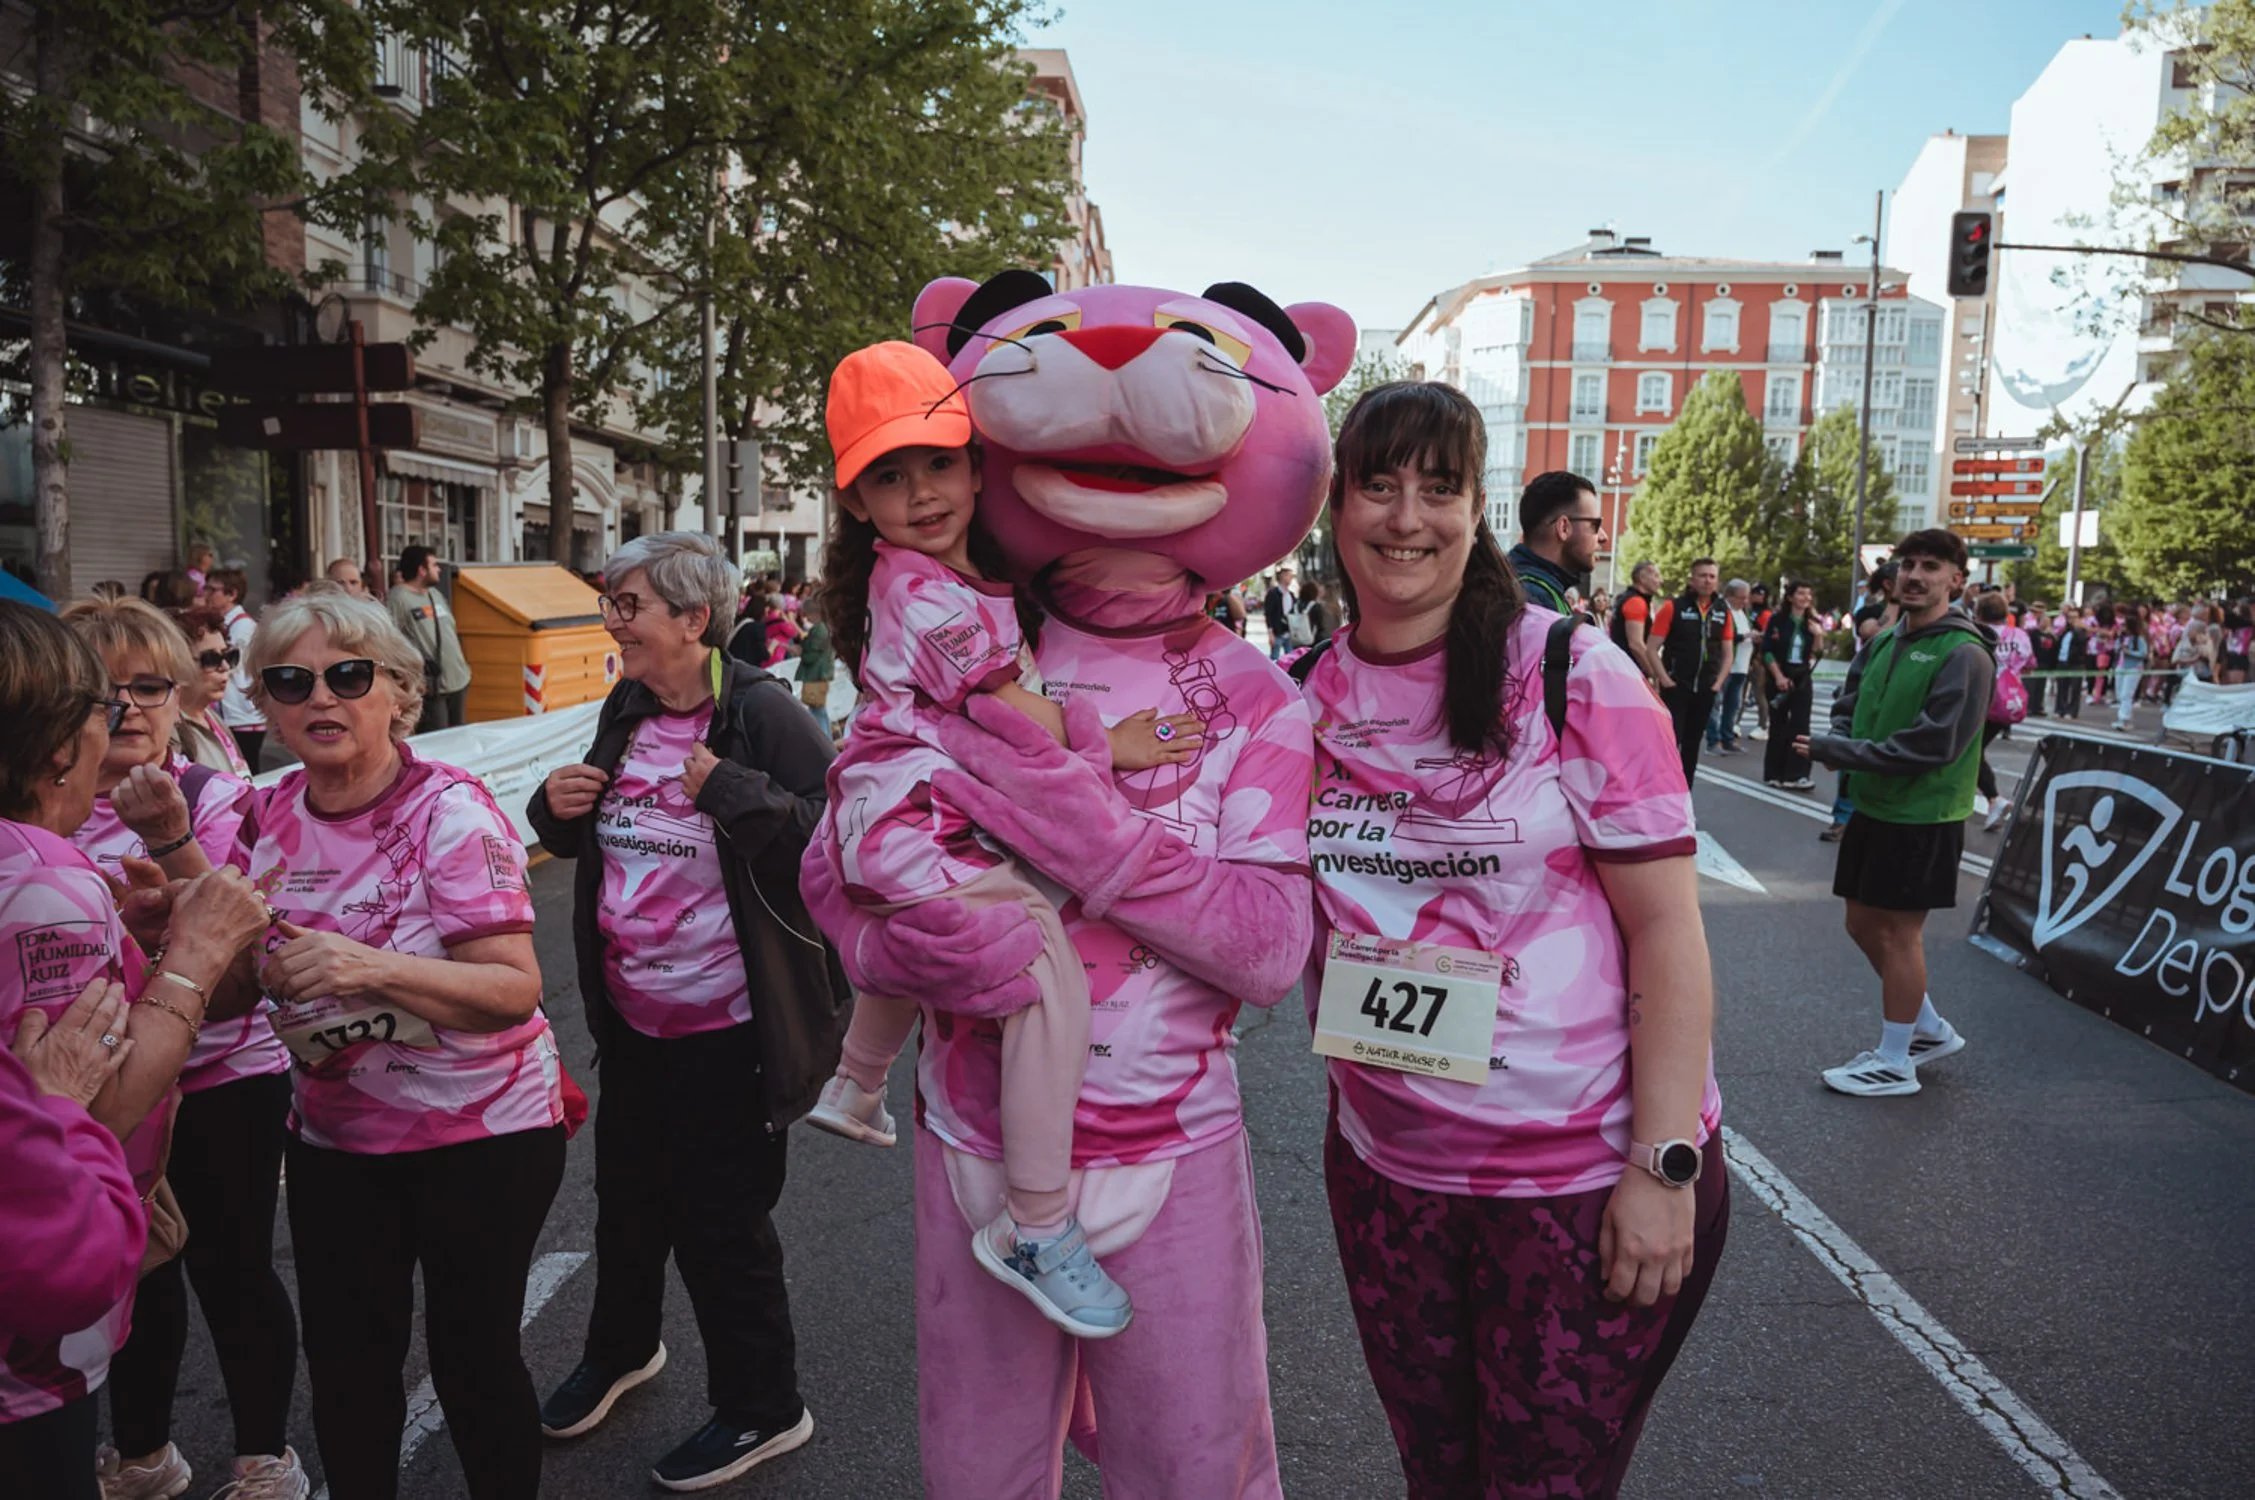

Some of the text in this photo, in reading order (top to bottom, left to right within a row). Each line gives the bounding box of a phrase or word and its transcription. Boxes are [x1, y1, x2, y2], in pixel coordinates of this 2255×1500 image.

[1318, 787, 1408, 813] Carrera
[616, 810, 632, 829] la
[1307, 818, 1386, 842] por la
[595, 834, 697, 860] nvestigación
[1312, 851, 1501, 885] nvestigación
[28, 943, 110, 966] HUMILDAD
[29, 963, 70, 984] RUIZ
[1360, 976, 1448, 1037] 427
[1366, 1046, 1400, 1059] NATUR
[1402, 1052, 1437, 1068] HOUSE
